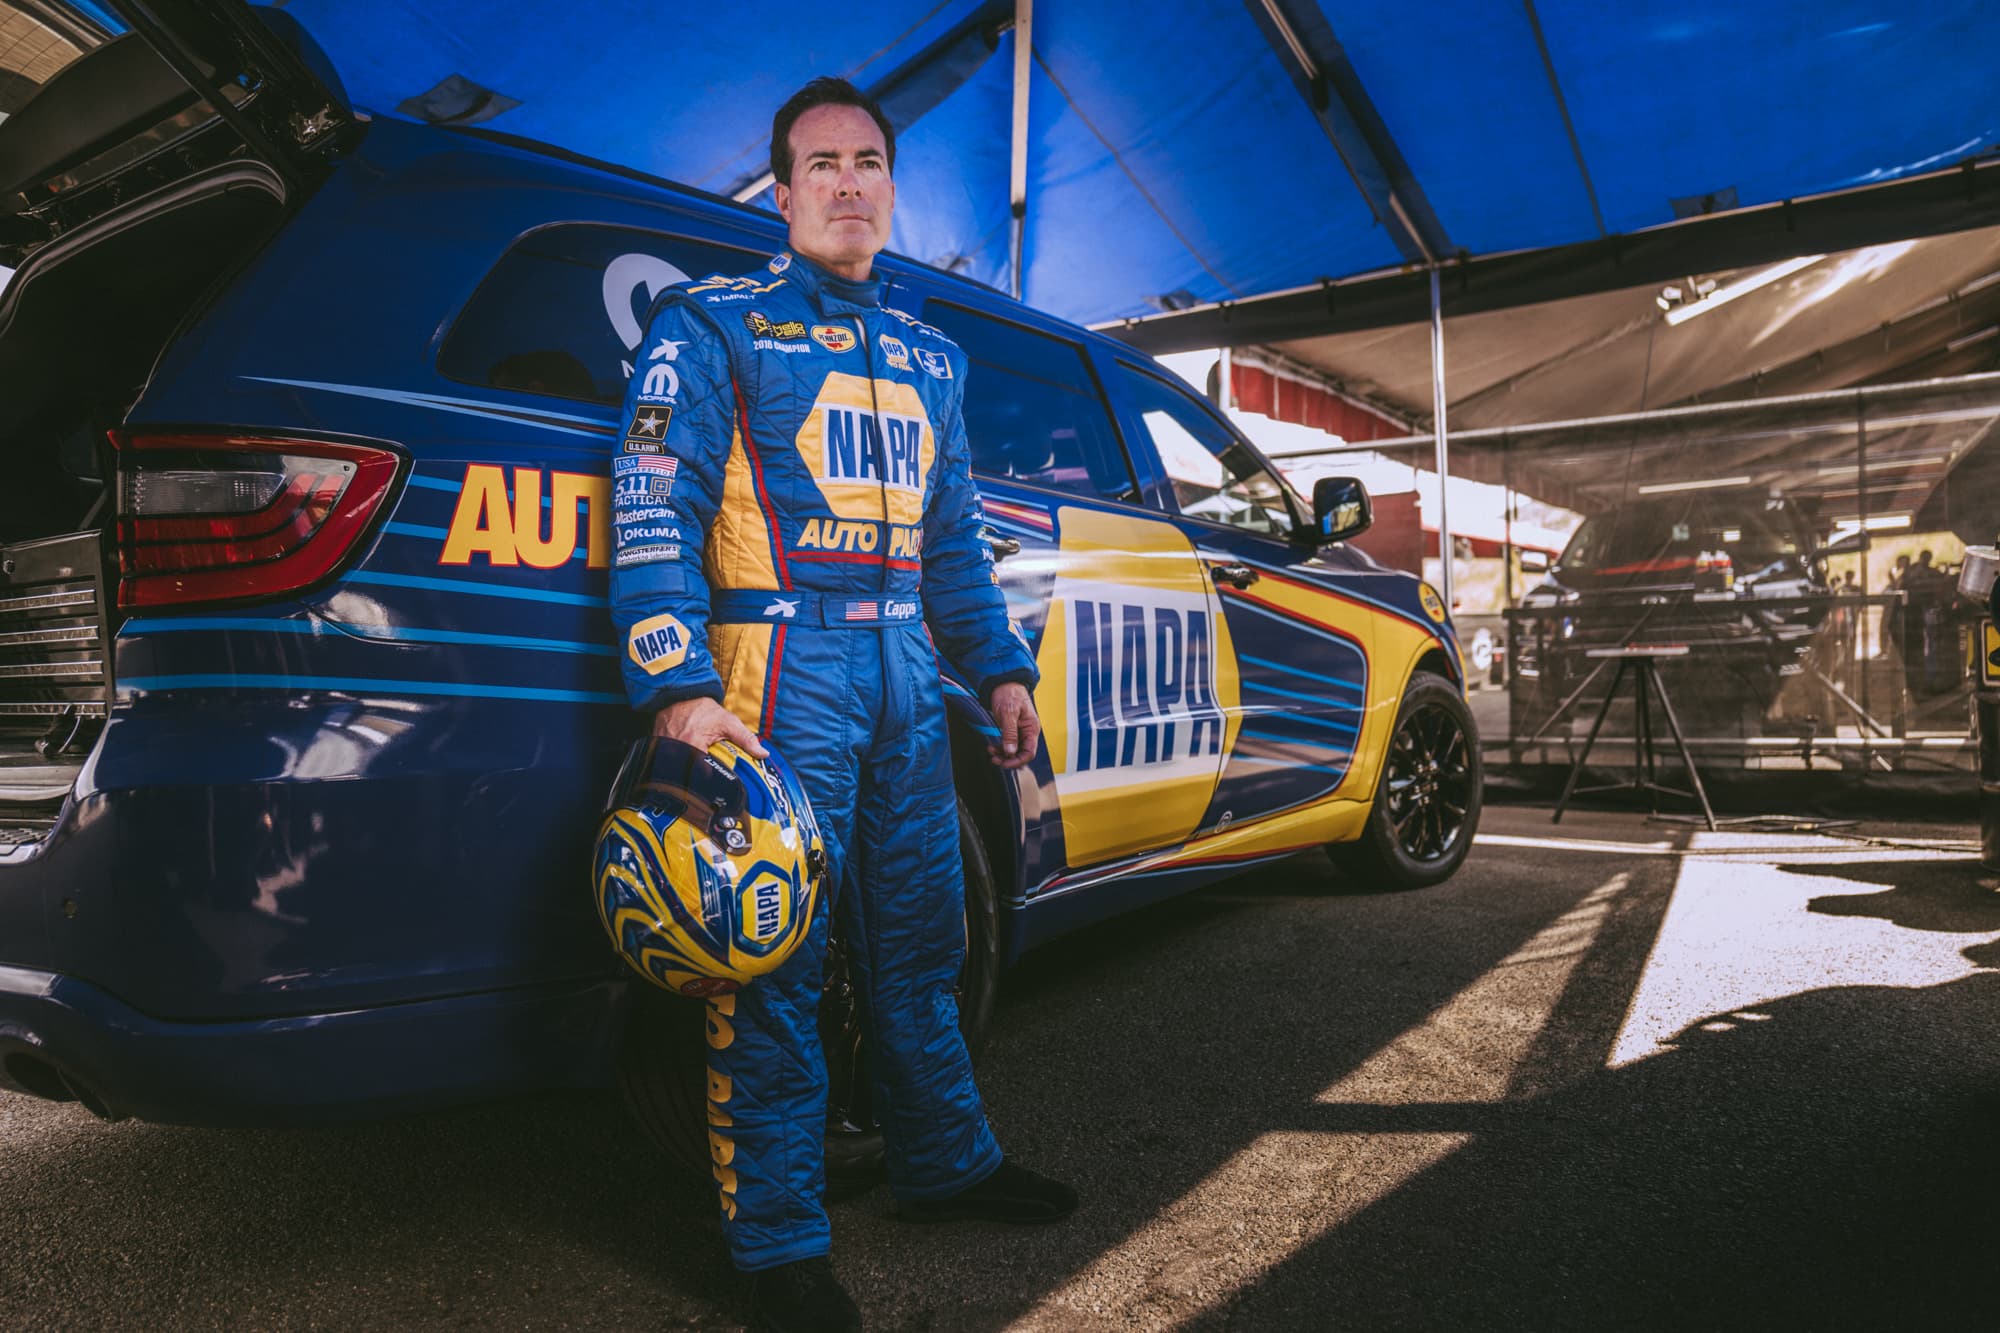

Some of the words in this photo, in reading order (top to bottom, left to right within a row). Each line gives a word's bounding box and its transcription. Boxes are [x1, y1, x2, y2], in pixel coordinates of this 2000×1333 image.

[617, 459, 637, 469] USA
[828, 409, 920, 488] NAPA
[615, 476, 648, 498] 5.11
[615, 495, 670, 507] TACTICAL
[438, 462, 612, 570] AUT
[613, 507, 675, 526] Mastercam
[797, 519, 878, 552] AUTO
[884, 600, 917, 619] Capps
[634, 625, 682, 663] NAPA
[1075, 600, 1221, 772] NAPA
[757, 882, 780, 937] NAPA
